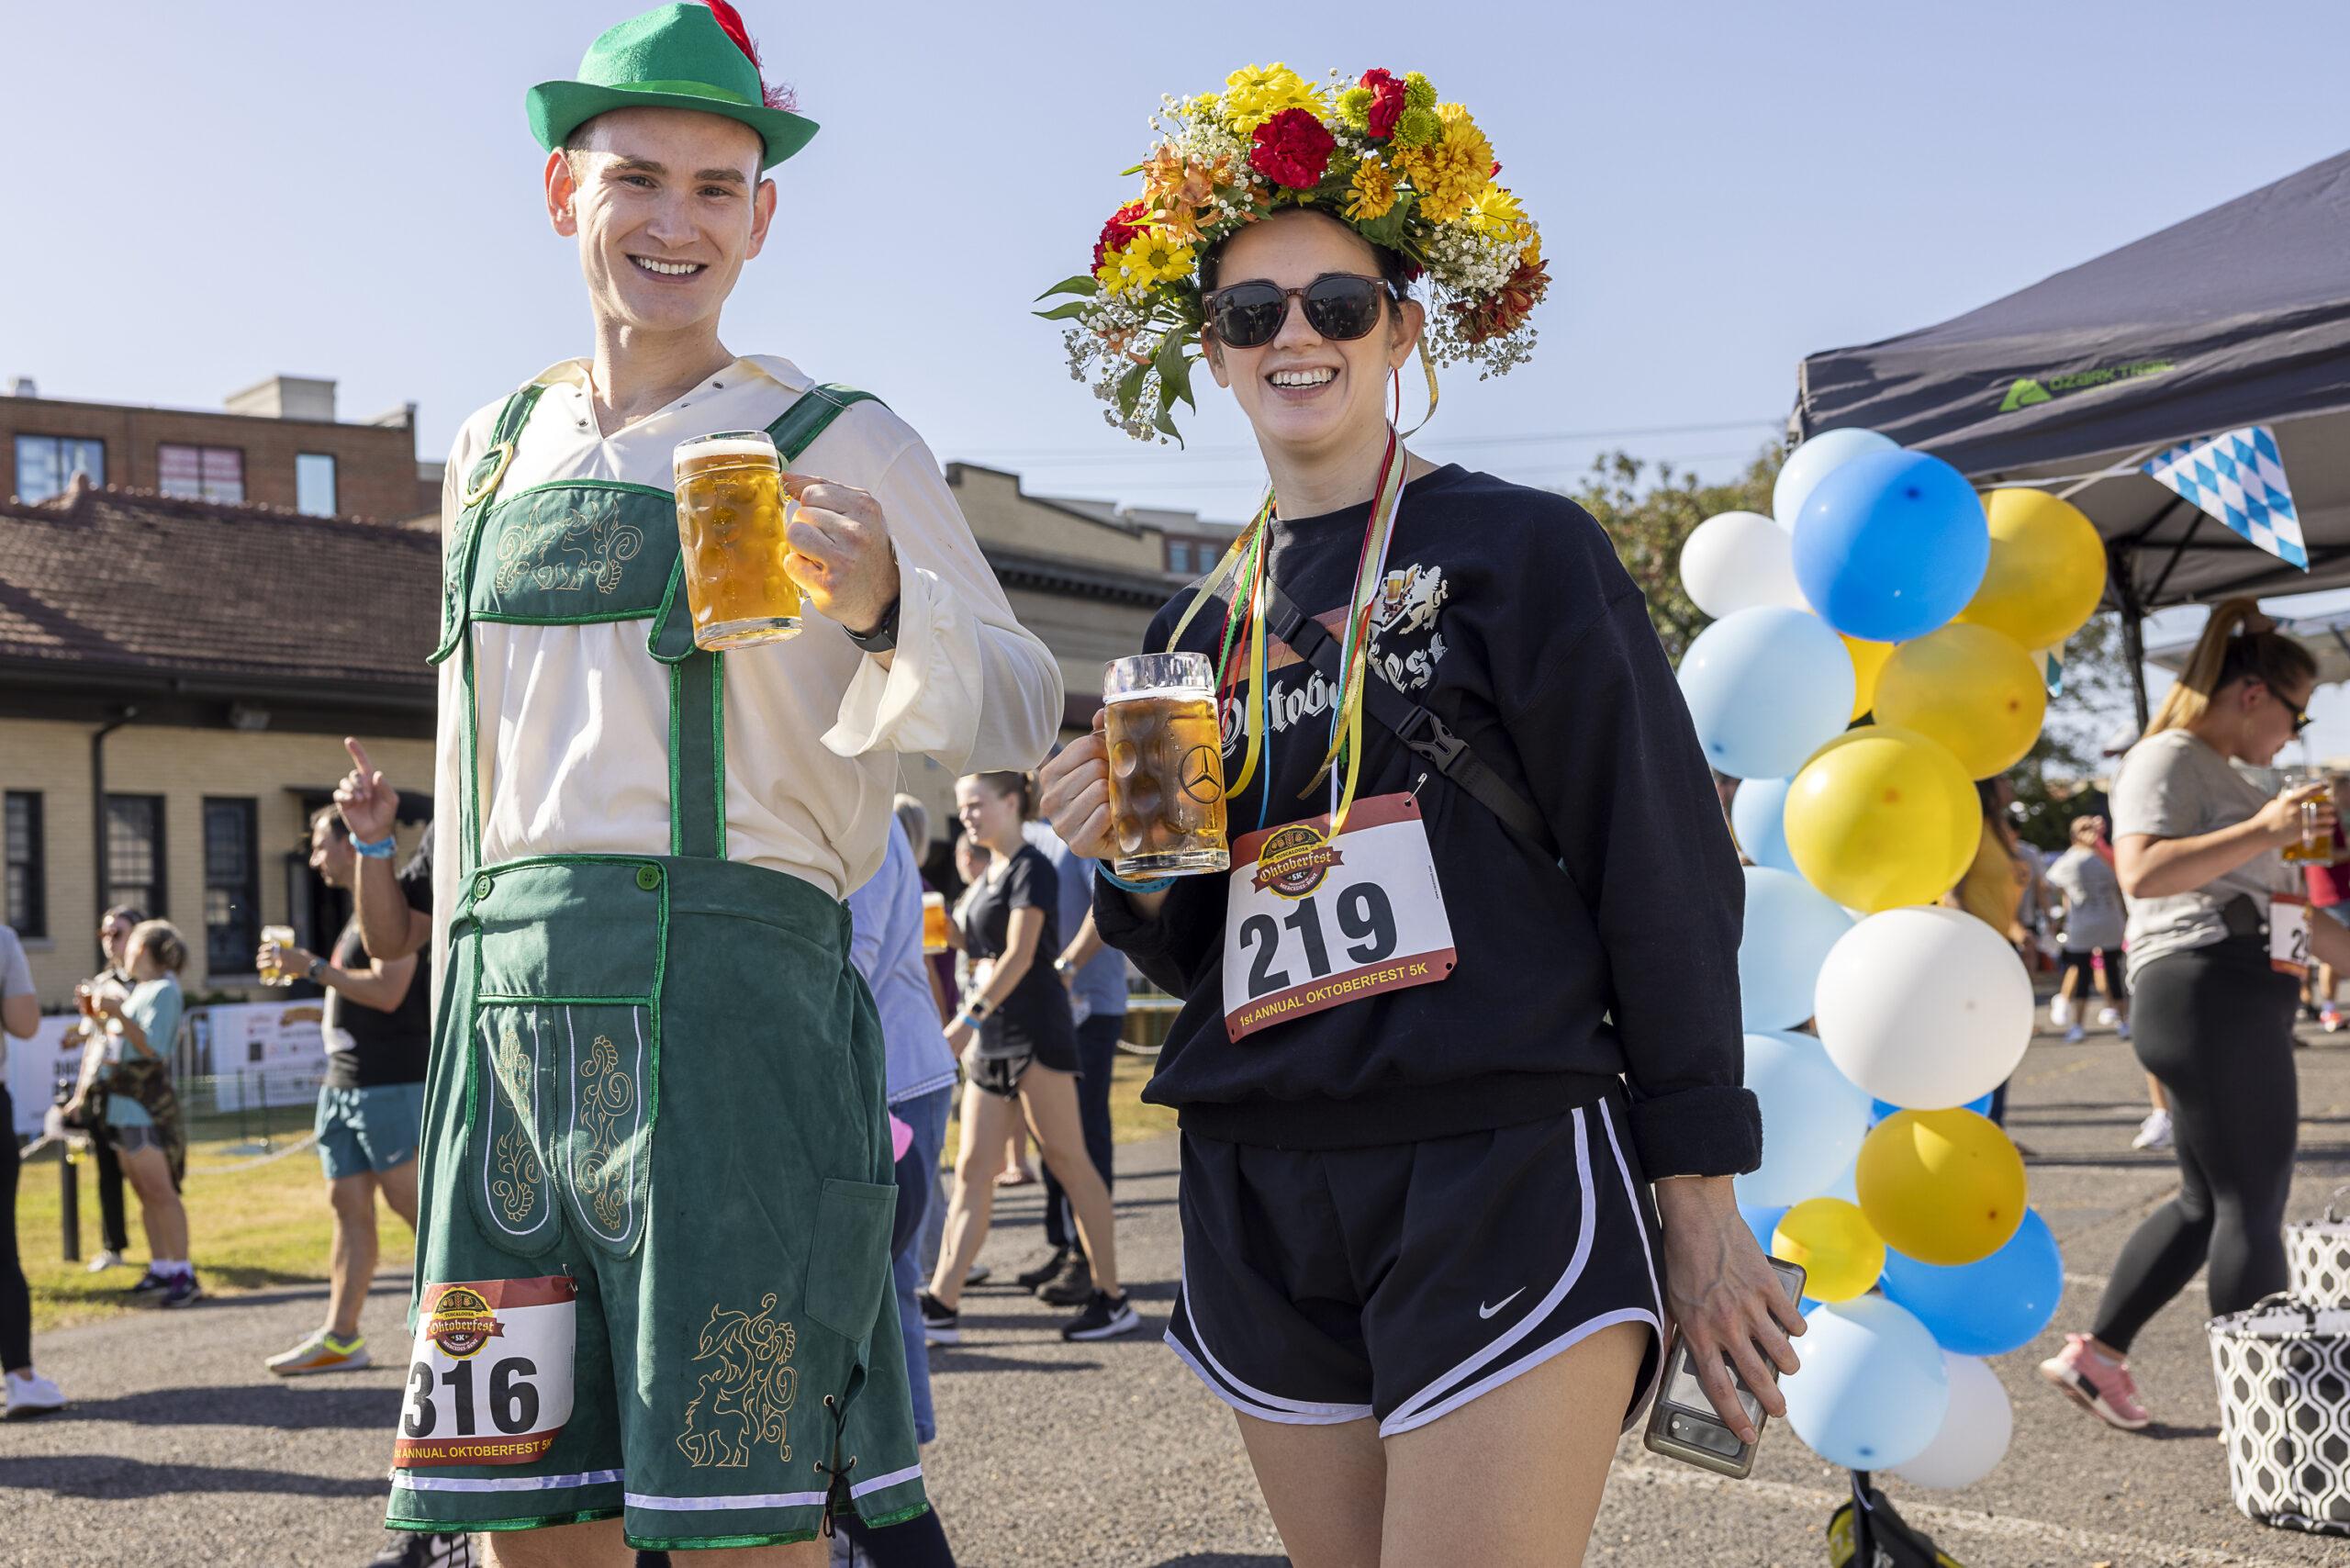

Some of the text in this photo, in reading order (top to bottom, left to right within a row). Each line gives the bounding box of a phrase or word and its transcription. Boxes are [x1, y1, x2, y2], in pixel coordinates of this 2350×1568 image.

[1276, 846, 1309, 860] TUSCALOOSA
[1259, 850, 1332, 882] Oktoberfest
[1292, 871, 1304, 881] 5K
[1239, 881, 1398, 1001] 219
[1239, 962, 1429, 1027] 1st ANNUAL OKTOBERFEST 5K
[430, 1318, 495, 1335] Oktoberfest
[404, 1356, 540, 1439] 316
[402, 1447, 447, 1459] ANNUAL
[449, 1440, 540, 1459] OKTOBERFEST
